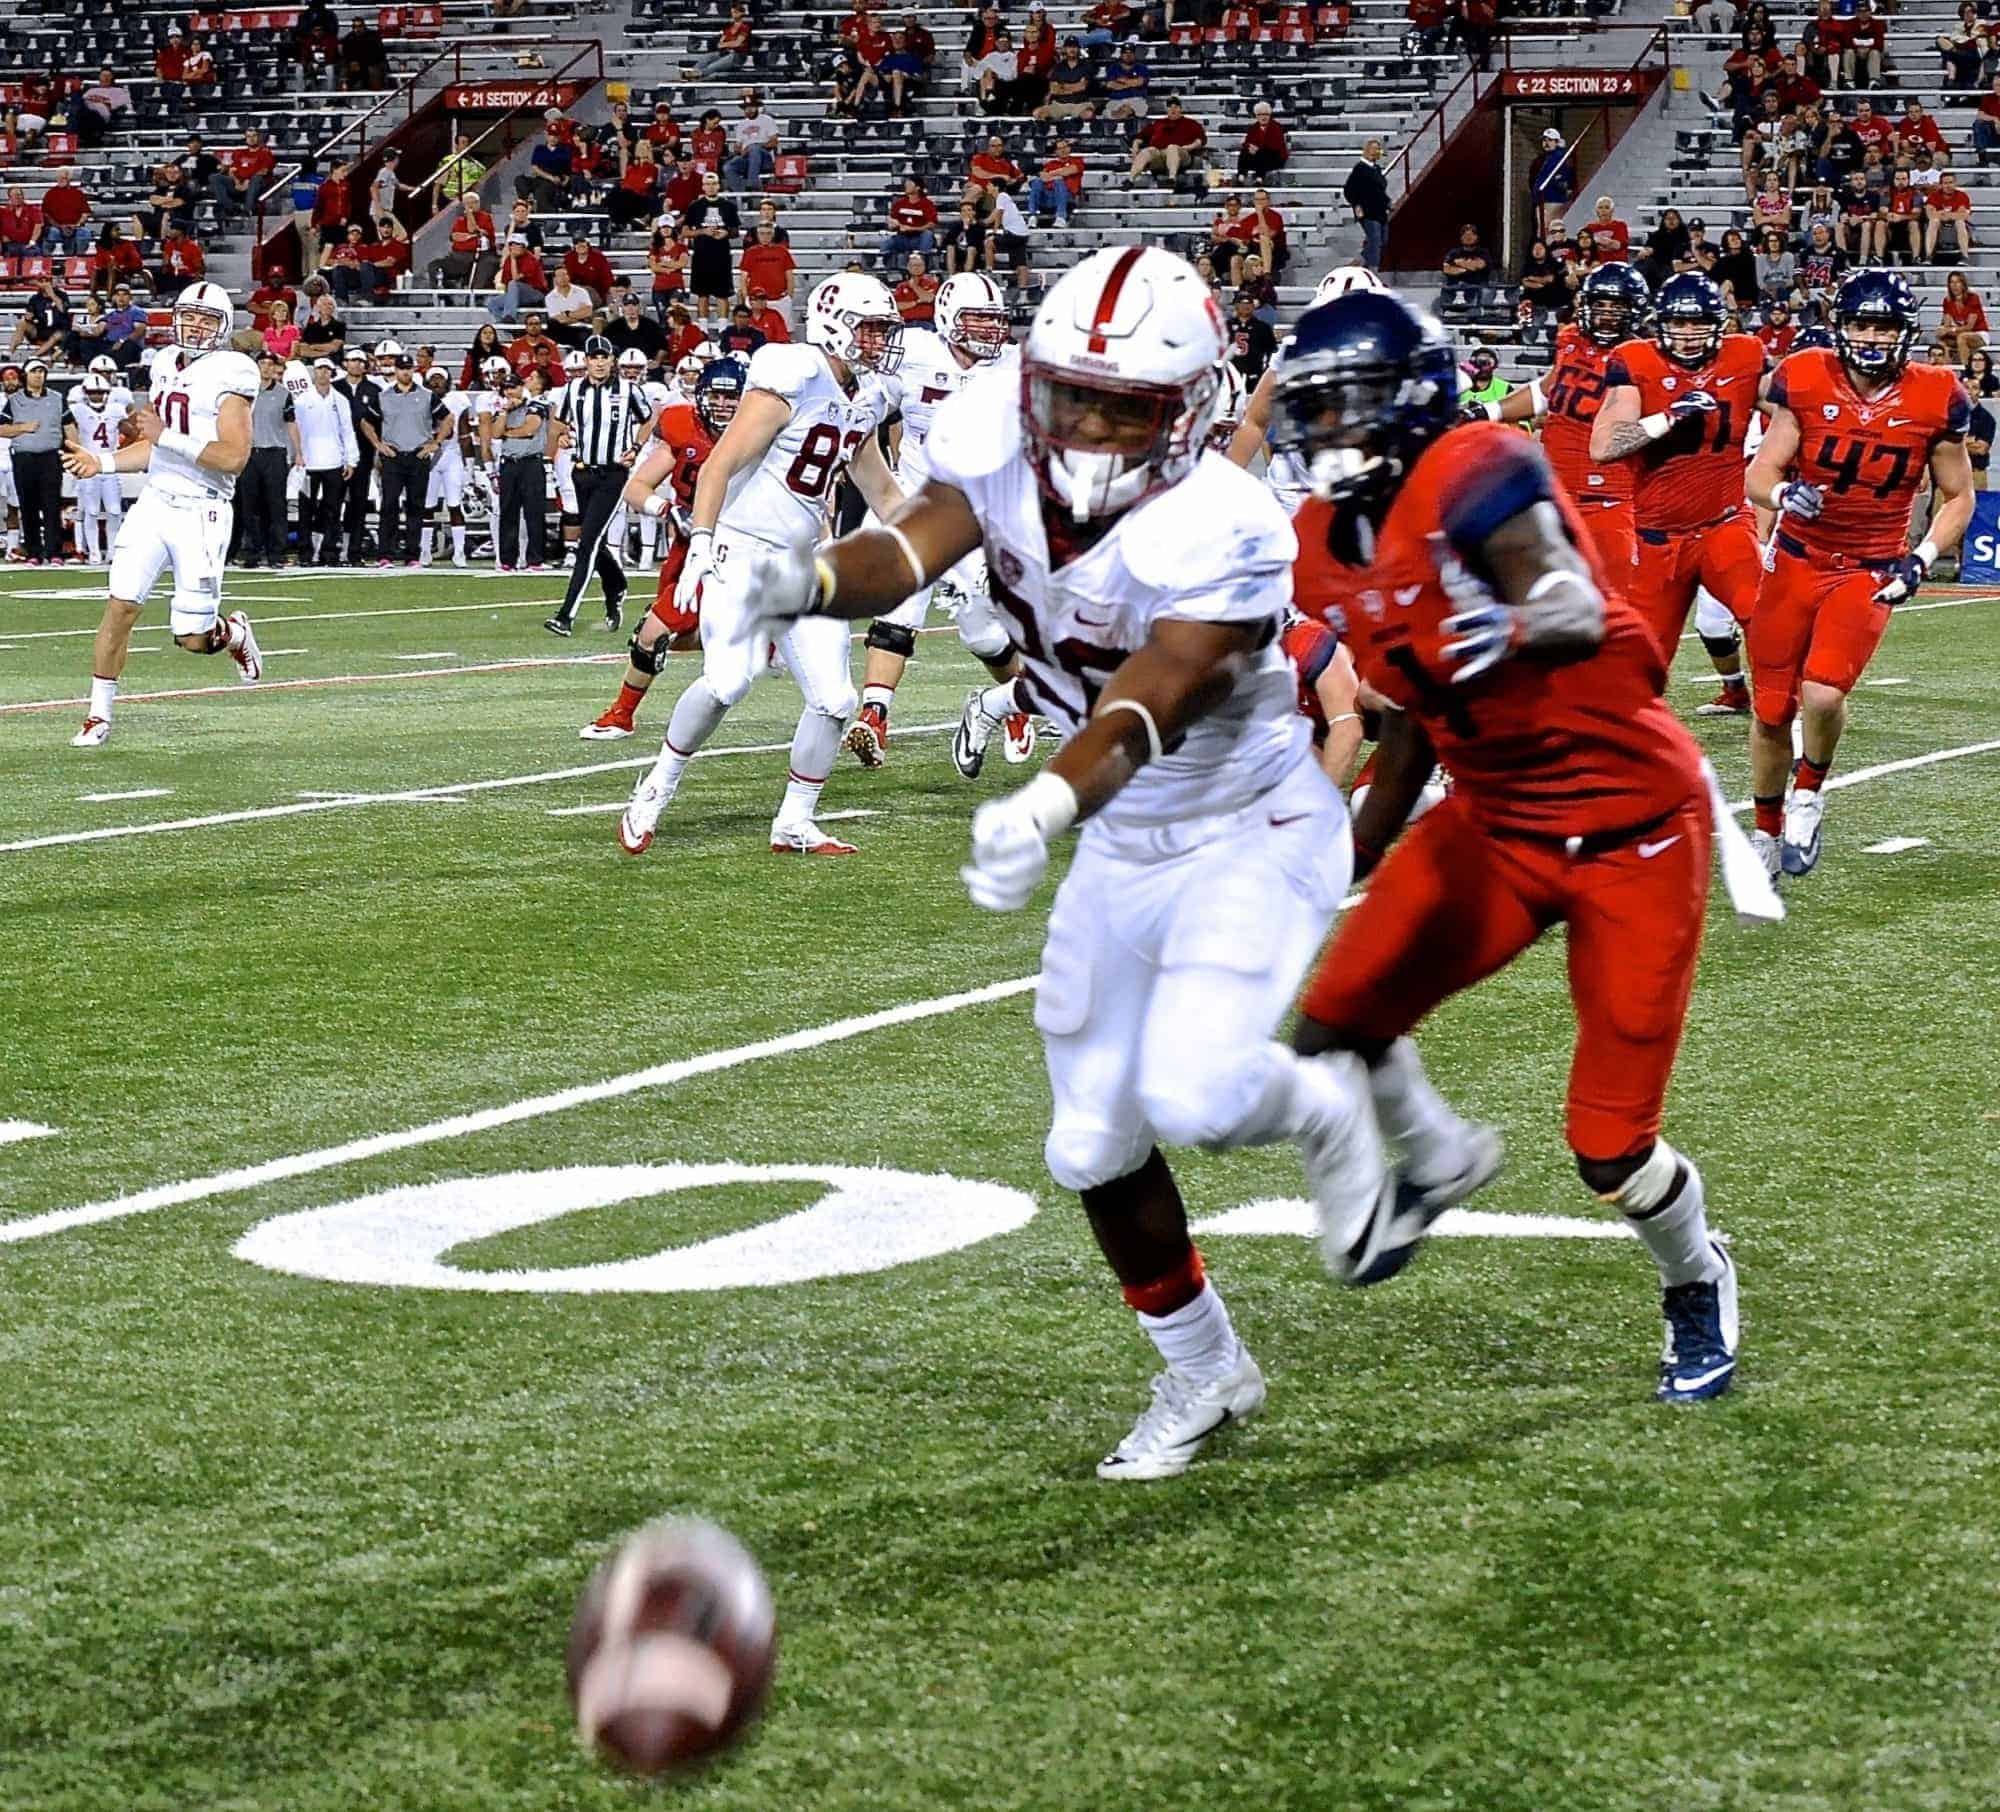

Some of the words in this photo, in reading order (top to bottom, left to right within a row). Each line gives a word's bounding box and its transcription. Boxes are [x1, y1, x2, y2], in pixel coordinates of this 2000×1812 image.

[1531, 78, 1546, 93] 22
[1550, 78, 1600, 93] SECTION
[1603, 78, 1618, 93] 23
[471, 91, 484, 106] 21
[287, 377, 309, 391] BIG
[1549, 364, 1604, 424] 62
[93, 421, 109, 449] 4
[1814, 434, 1912, 501] 47
